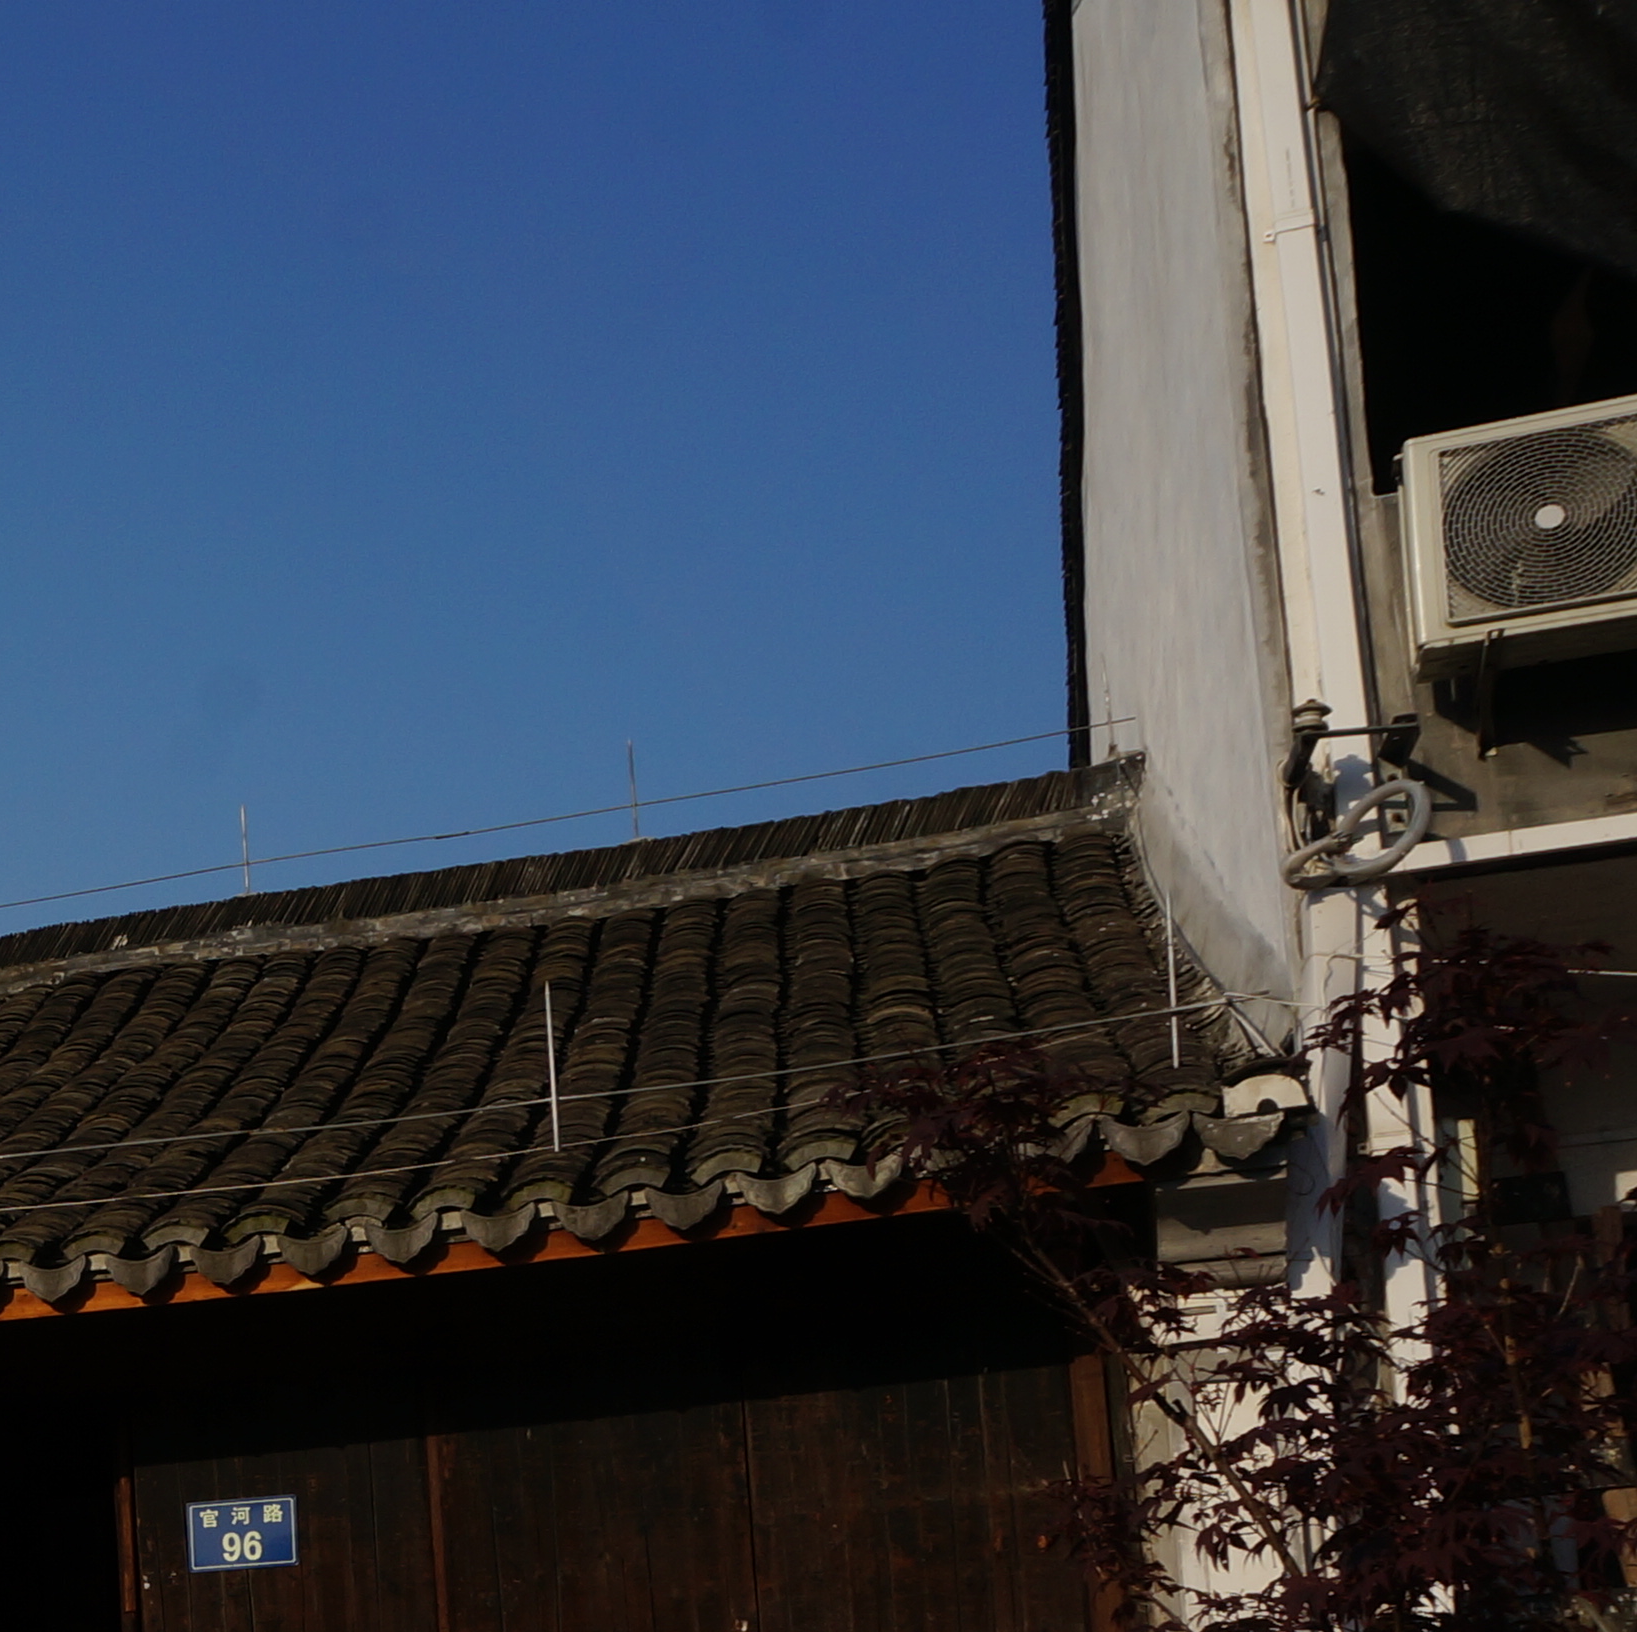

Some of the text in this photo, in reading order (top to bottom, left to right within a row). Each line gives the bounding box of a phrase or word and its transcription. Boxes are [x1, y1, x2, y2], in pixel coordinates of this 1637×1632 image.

[199, 1504, 283, 1528] 官河路
[222, 1531, 262, 1562] 96
